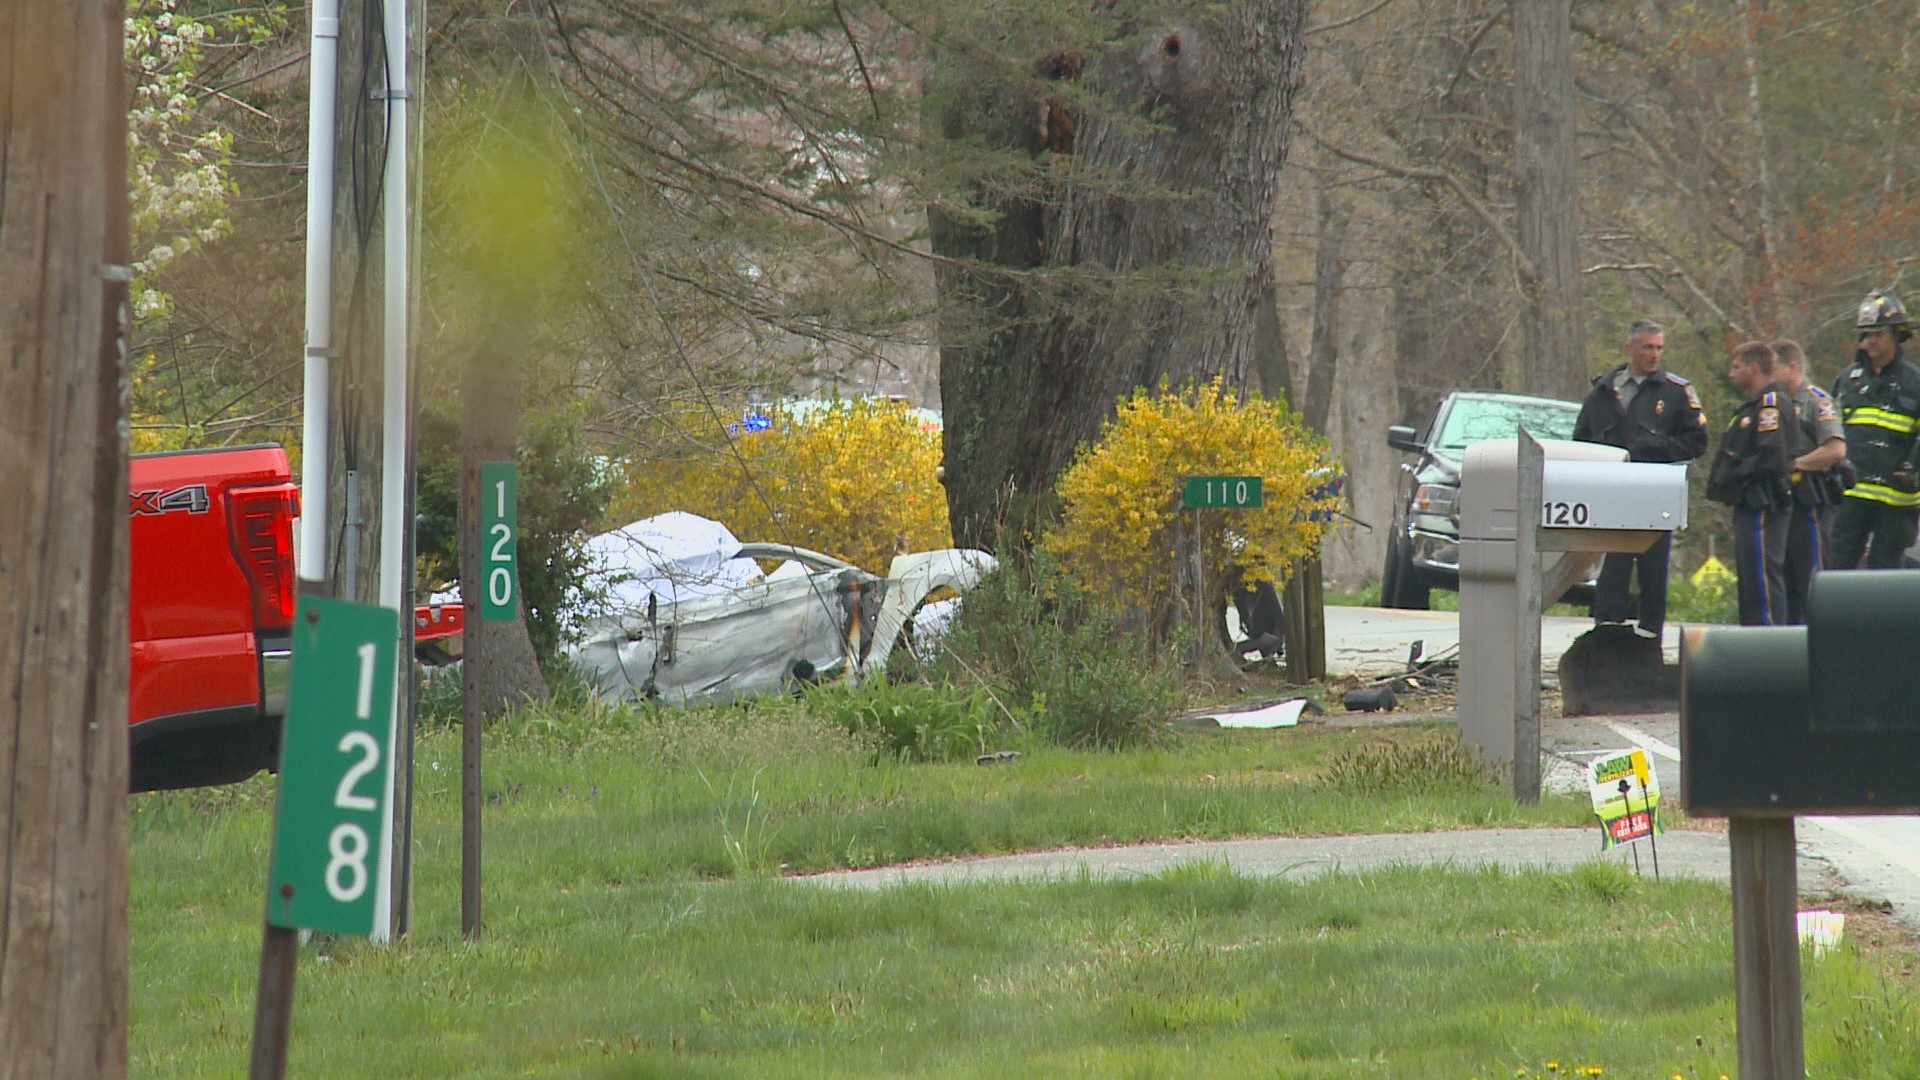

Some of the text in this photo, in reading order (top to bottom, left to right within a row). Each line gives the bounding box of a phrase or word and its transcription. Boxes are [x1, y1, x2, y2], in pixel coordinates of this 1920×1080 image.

[1206, 481, 1247, 504] 110
[1543, 502, 1589, 525] 120
[488, 480, 513, 607] 120
[325, 642, 381, 903] 128
[1597, 755, 1632, 775] LAW
